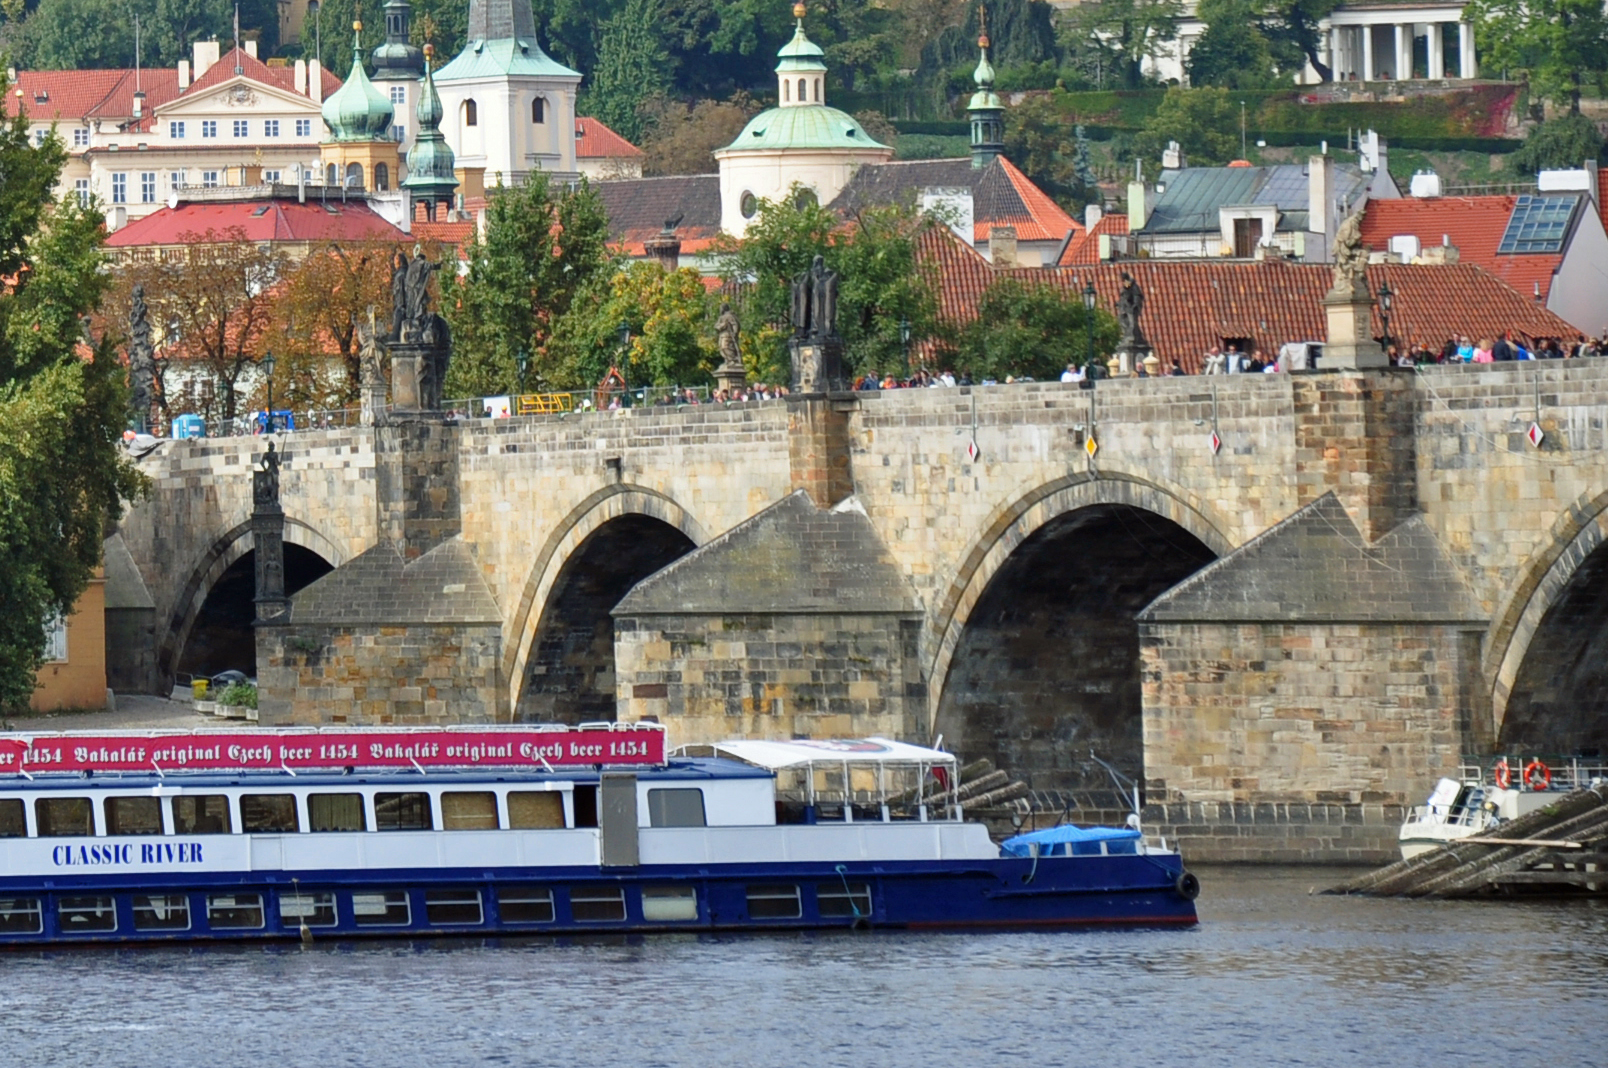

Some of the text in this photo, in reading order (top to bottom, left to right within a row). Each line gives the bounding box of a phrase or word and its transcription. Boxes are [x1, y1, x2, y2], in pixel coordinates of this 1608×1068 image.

[23, 746, 63, 764] 1454
[74, 745, 146, 763] Bakalář
[152, 744, 221, 765] original
[227, 743, 272, 764] Czech
[279, 743, 313, 760] beer
[318, 744, 359, 759] 1454
[369, 743, 440, 759] Bakalář
[446, 741, 513, 762] original
[519, 740, 563, 761] Czech
[569, 740, 603, 757] beer
[609, 740, 648, 757] 1454
[52, 843, 203, 866] CLASSIC RIVER
